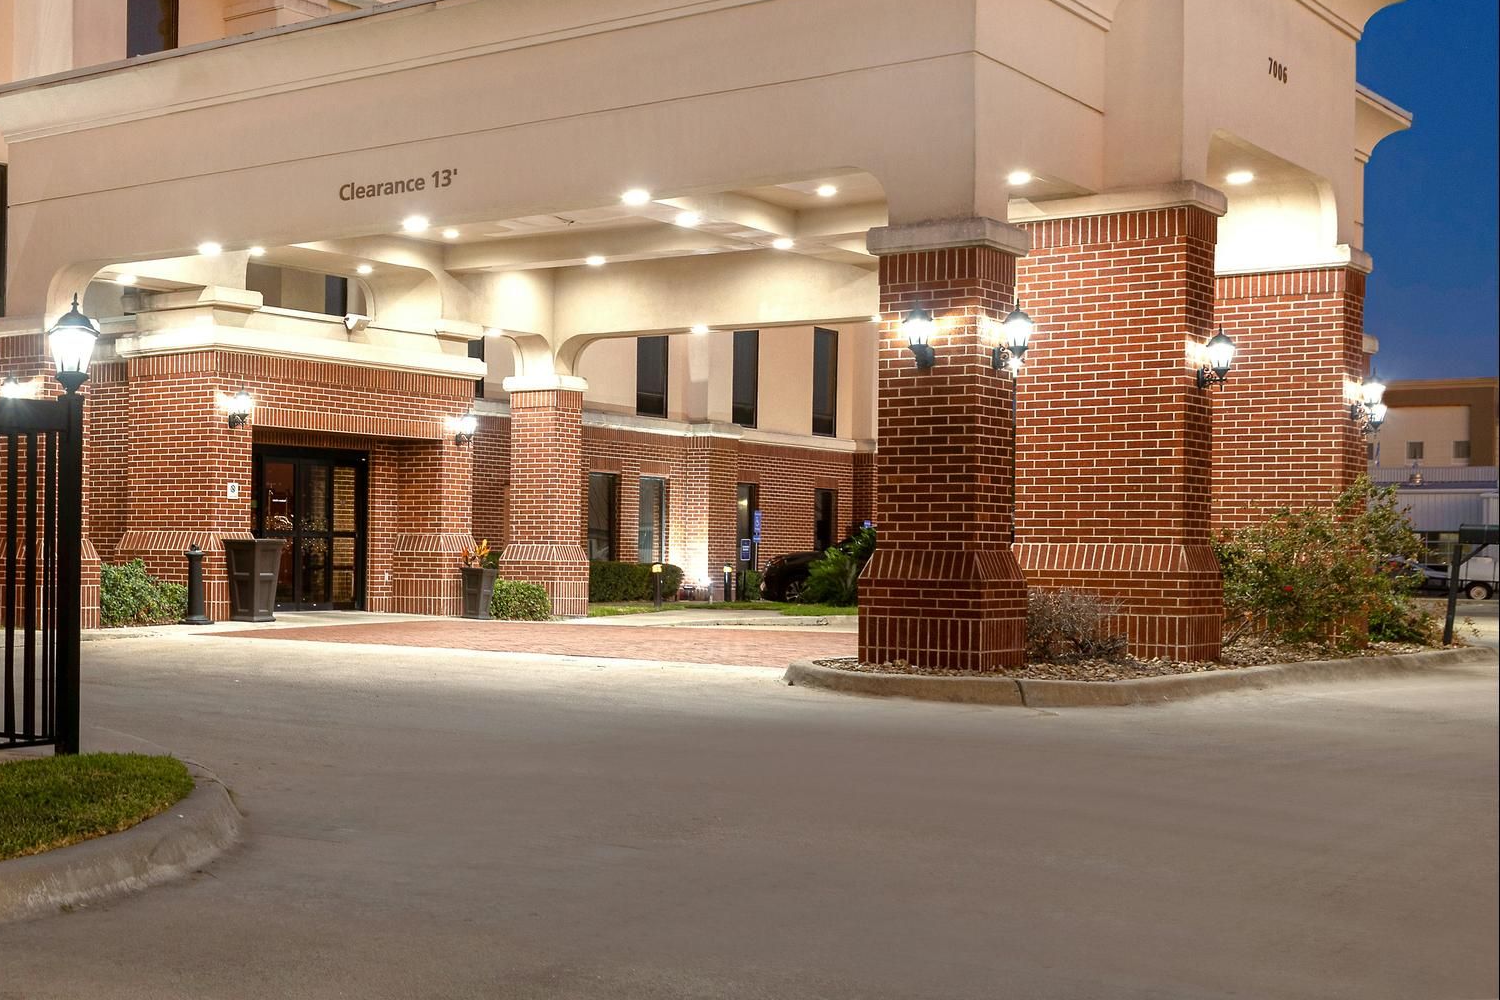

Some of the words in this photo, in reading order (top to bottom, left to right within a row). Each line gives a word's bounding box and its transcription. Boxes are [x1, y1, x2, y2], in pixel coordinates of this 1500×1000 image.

[1268, 56, 1288, 85] 7006
[339, 176, 426, 201] Clearance
[431, 168, 458, 189] 13'
